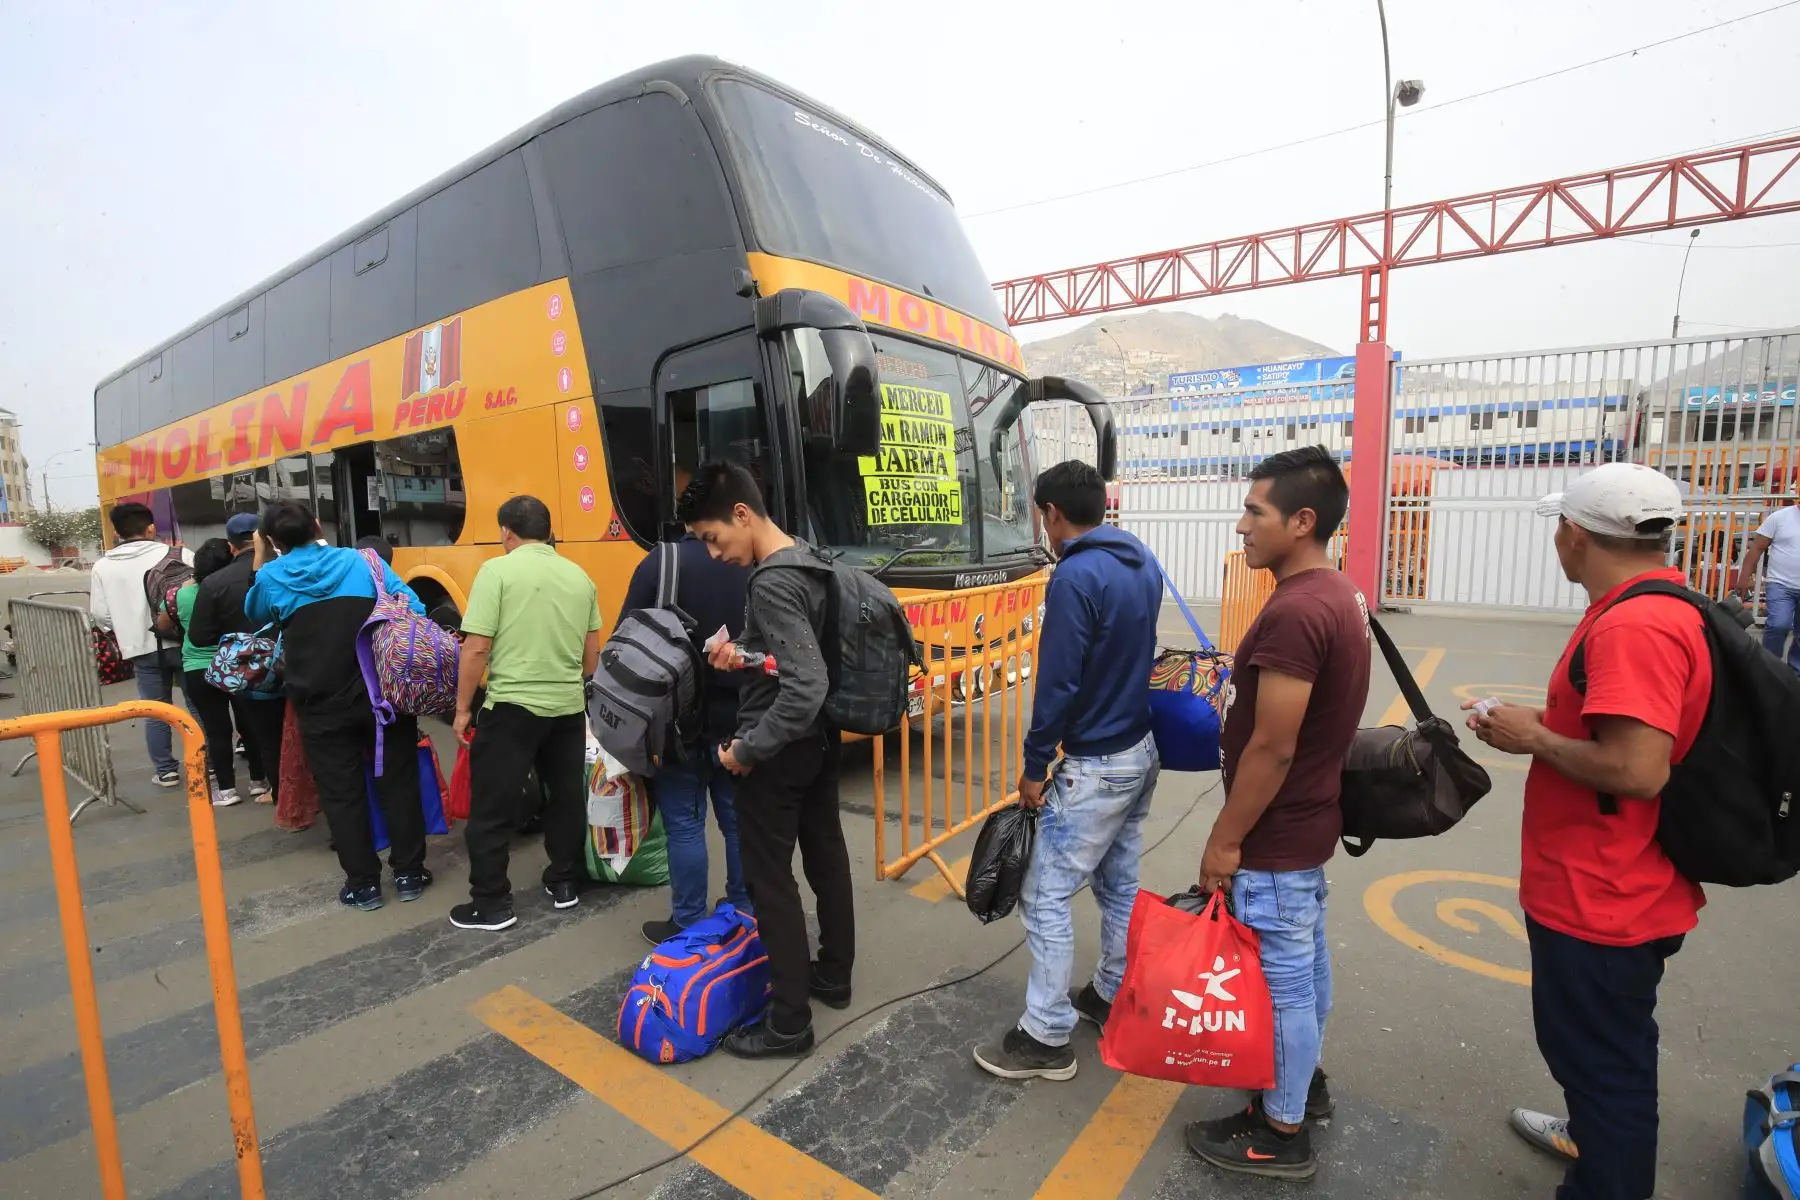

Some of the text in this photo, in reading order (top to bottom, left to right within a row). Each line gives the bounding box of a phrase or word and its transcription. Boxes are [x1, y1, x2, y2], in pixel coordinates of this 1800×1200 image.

[855, 141, 882, 164] De
[848, 278, 1023, 371] MOLINA
[1262, 362, 1304, 373] HUANCAYO
[1262, 372, 1290, 381] SATIPO
[1172, 373, 1218, 385] TURISMO
[886, 386, 945, 416] MERCED
[128, 359, 518, 490] MOLINA PERU S.A.C.
[900, 419, 947, 447] RAMON
[874, 446, 950, 477] TARMA
[879, 478, 939, 493] BUS CON
[581, 494, 594, 504] WC
[868, 490, 949, 508] CARGADOR
[871, 506, 950, 524] DE CELULAR
[954, 570, 1008, 589] Marcopolo
[599, 703, 622, 731] CAT
[1161, 1006, 1246, 1036] I-RUN
